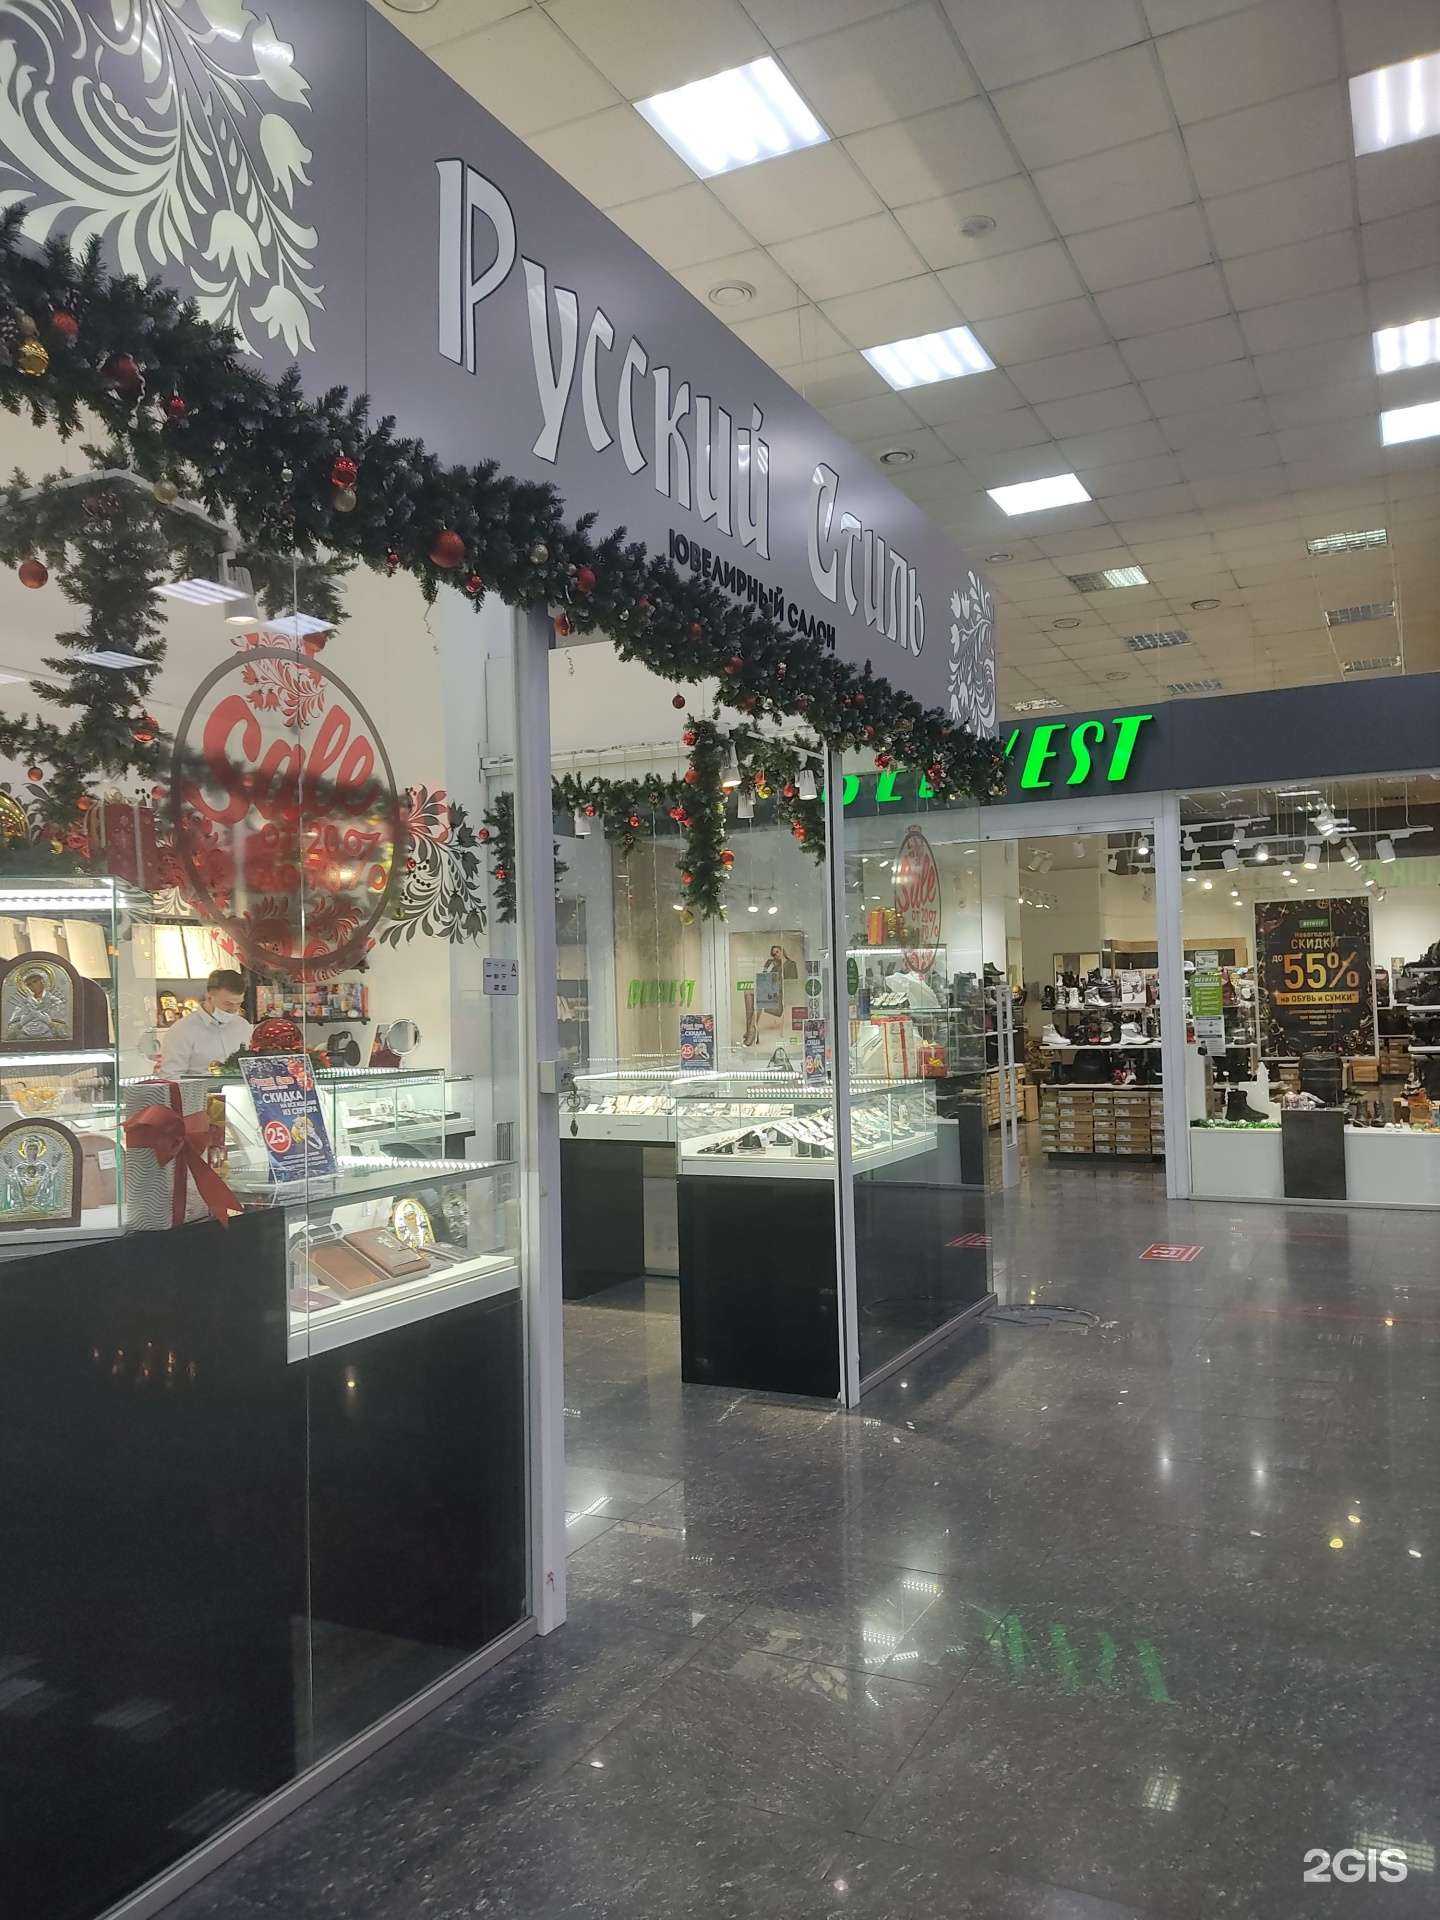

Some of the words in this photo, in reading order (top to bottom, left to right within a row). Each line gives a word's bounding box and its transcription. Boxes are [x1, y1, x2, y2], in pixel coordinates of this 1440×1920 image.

[434, 158, 771, 561] Русский
[808, 462, 926, 658] Стиль
[669, 528, 785, 622] ЮВЕЛИРНЫЙ
[187, 694, 381, 826] Sale
[1283, 951, 1359, 990] 55%
[1291, 938, 1339, 950] СКИДКИ
[262, 1090, 304, 1103] СКИДКА
